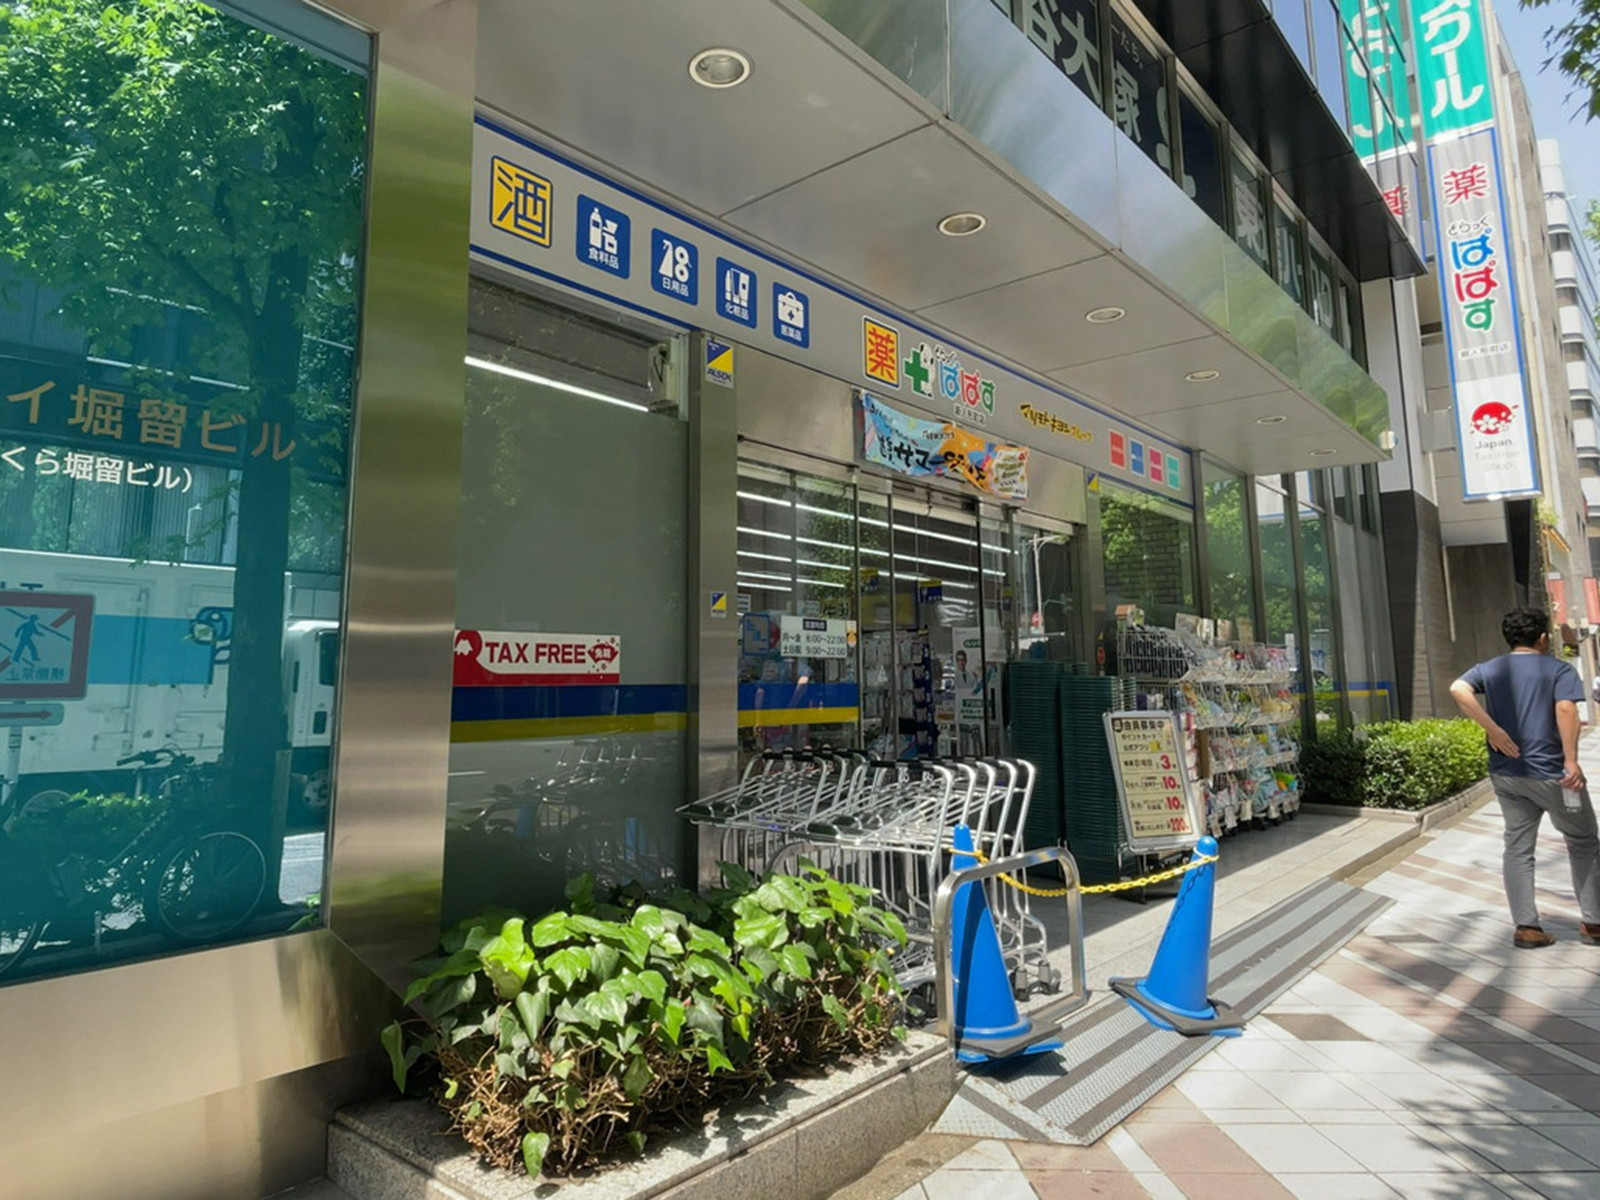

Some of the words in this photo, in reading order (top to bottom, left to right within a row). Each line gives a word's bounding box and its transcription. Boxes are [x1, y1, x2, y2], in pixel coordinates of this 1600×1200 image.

[1443, 164, 1488, 204] 薬
[495, 163, 549, 240] 酒
[588, 247, 619, 269] 食料品
[662, 277, 689, 297] 日用品
[868, 326, 896, 381] 薬
[7, 380, 296, 461] イ堀留ビル
[1475, 438, 1513, 450] Japan
[485, 642, 529, 664] TAX
[534, 644, 586, 664] FREE
